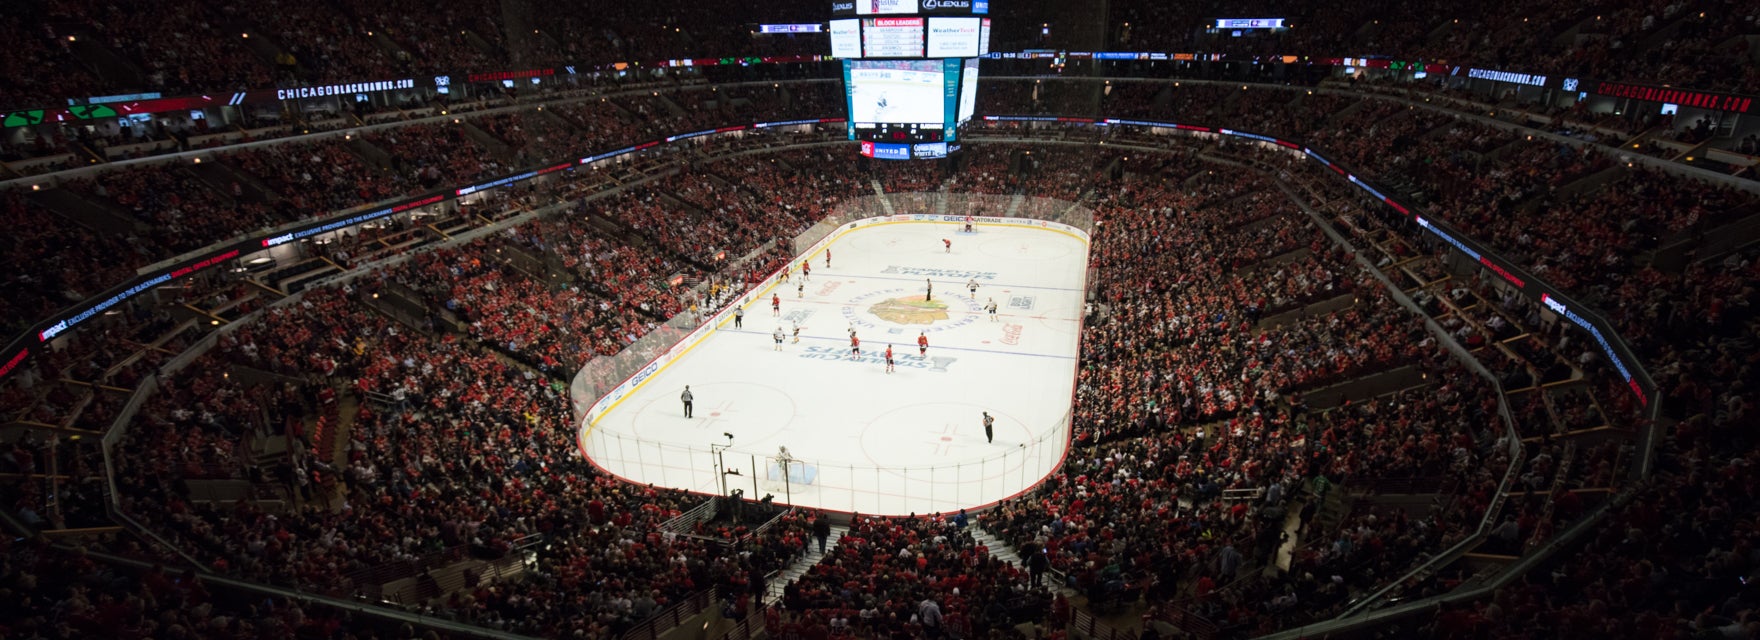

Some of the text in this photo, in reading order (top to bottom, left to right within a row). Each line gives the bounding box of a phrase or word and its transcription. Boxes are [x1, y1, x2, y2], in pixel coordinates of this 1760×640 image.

[277, 79, 414, 100] CHICAGOBLACKHAWKS.COM
[1468, 68, 1547, 87] CHICAGOBLACKHAWKS.COM
[1598, 82, 1752, 113] CHICAGOBLACKHAWKS.COM
[267, 232, 294, 247] impact
[294, 226, 322, 239] EXCLUSIVE
[321, 220, 346, 233] PROVIDER
[363, 207, 393, 221] BLACKHAWKS
[42, 319, 69, 340] impact
[67, 307, 96, 327] EXCLUSIVE
[95, 294, 120, 313] PROVIDER
[135, 272, 172, 293] BLACKHAWKS
[1544, 294, 1566, 315] impact
[1565, 309, 1592, 331] EXCLUSIVE
[631, 362, 658, 387] GEICO
